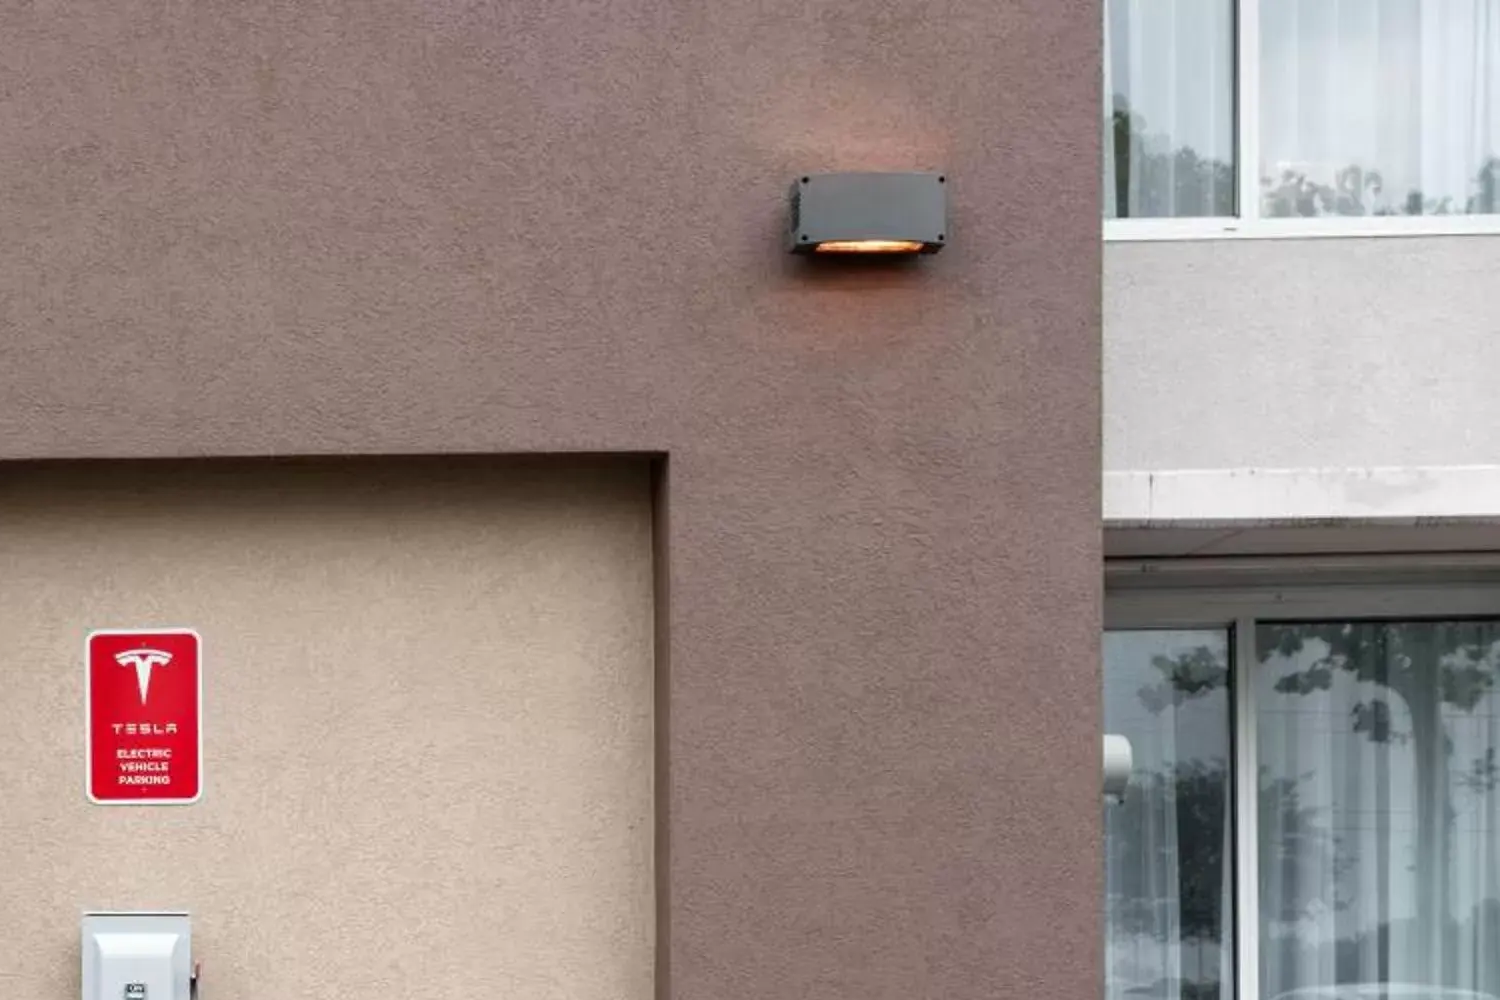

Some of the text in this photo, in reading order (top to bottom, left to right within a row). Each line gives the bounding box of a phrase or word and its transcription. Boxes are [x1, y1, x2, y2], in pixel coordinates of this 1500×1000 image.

[111, 723, 177, 734] TESLA
[116, 749, 172, 759] ELECTRIC
[119, 761, 169, 771] VEHICLE
[118, 775, 171, 785] PARKING
